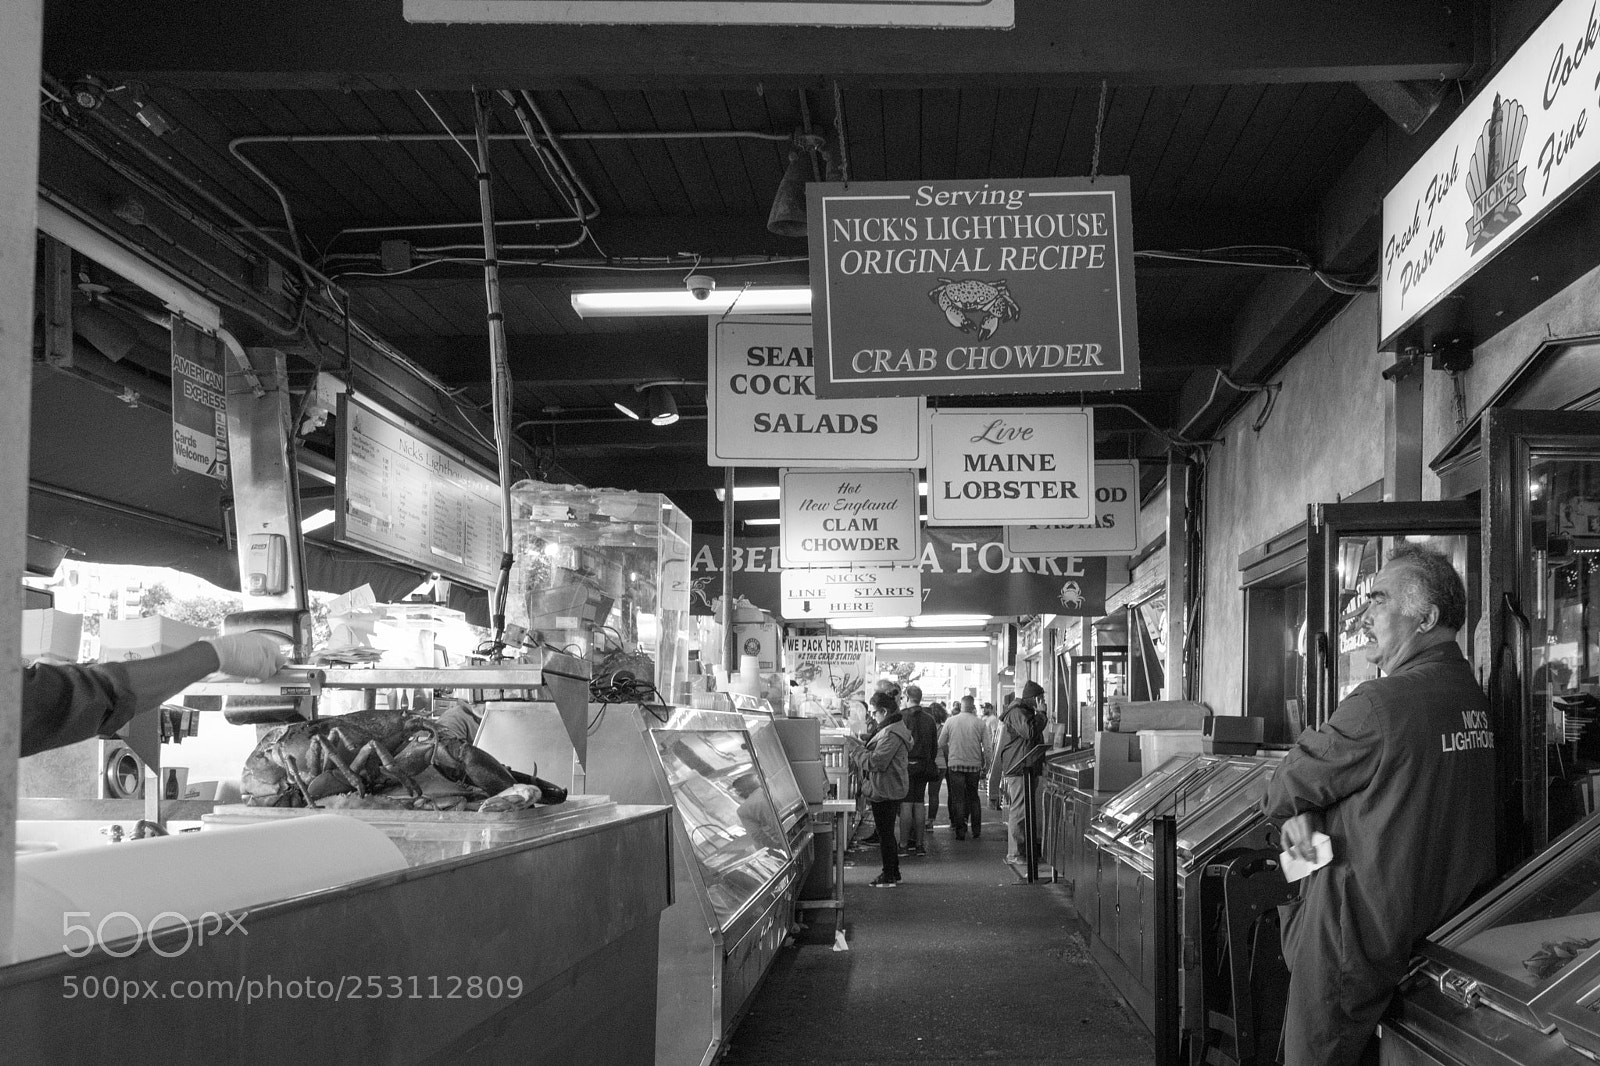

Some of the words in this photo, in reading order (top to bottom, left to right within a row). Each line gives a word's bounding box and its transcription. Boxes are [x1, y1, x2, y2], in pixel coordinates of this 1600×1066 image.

[1537, 108, 1588, 198] Fine
[915, 184, 1025, 210] Serving
[1475, 169, 1516, 222] NICK'S
[1385, 199, 1421, 281] Fresh
[1424, 145, 1460, 227] Fish
[832, 217, 918, 243] NICK'S
[925, 213, 1108, 241] LIGHTHOUSE
[840, 247, 992, 275] ORIGINAL
[998, 245, 1106, 272] RECIPE
[1400, 225, 1446, 311] Pasta
[852, 348, 937, 374] CRAB
[945, 343, 1104, 372] CHOWDER
[173, 355, 223, 391] AMERICAN
[184, 380, 227, 411] EXPRESS
[753, 412, 878, 435] SALADS
[970, 419, 1034, 445] Live
[174, 429, 198, 449] Cards
[399, 438, 424, 461] Nick's
[174, 441, 210, 465] Welcome
[963, 453, 1057, 472] MAINE
[837, 482, 862, 495] Hot
[944, 480, 1080, 500] LOBSTER
[799, 498, 829, 512] New
[833, 498, 898, 516] England
[822, 517, 879, 532] CLAM
[801, 537, 900, 552] CHOWDER
[826, 573, 877, 583] NICK'S
[788, 588, 827, 598] LINE
[854, 587, 914, 596] STARTS
[830, 602, 874, 611] HERE
[788, 639, 799, 651] WE
[802, 639, 823, 652] PACK
[826, 640, 841, 652] FOR
[844, 640, 873, 652] TRAVEL
[836, 653, 862, 661] STATION
[1461, 710, 1488, 729] NICK'S
